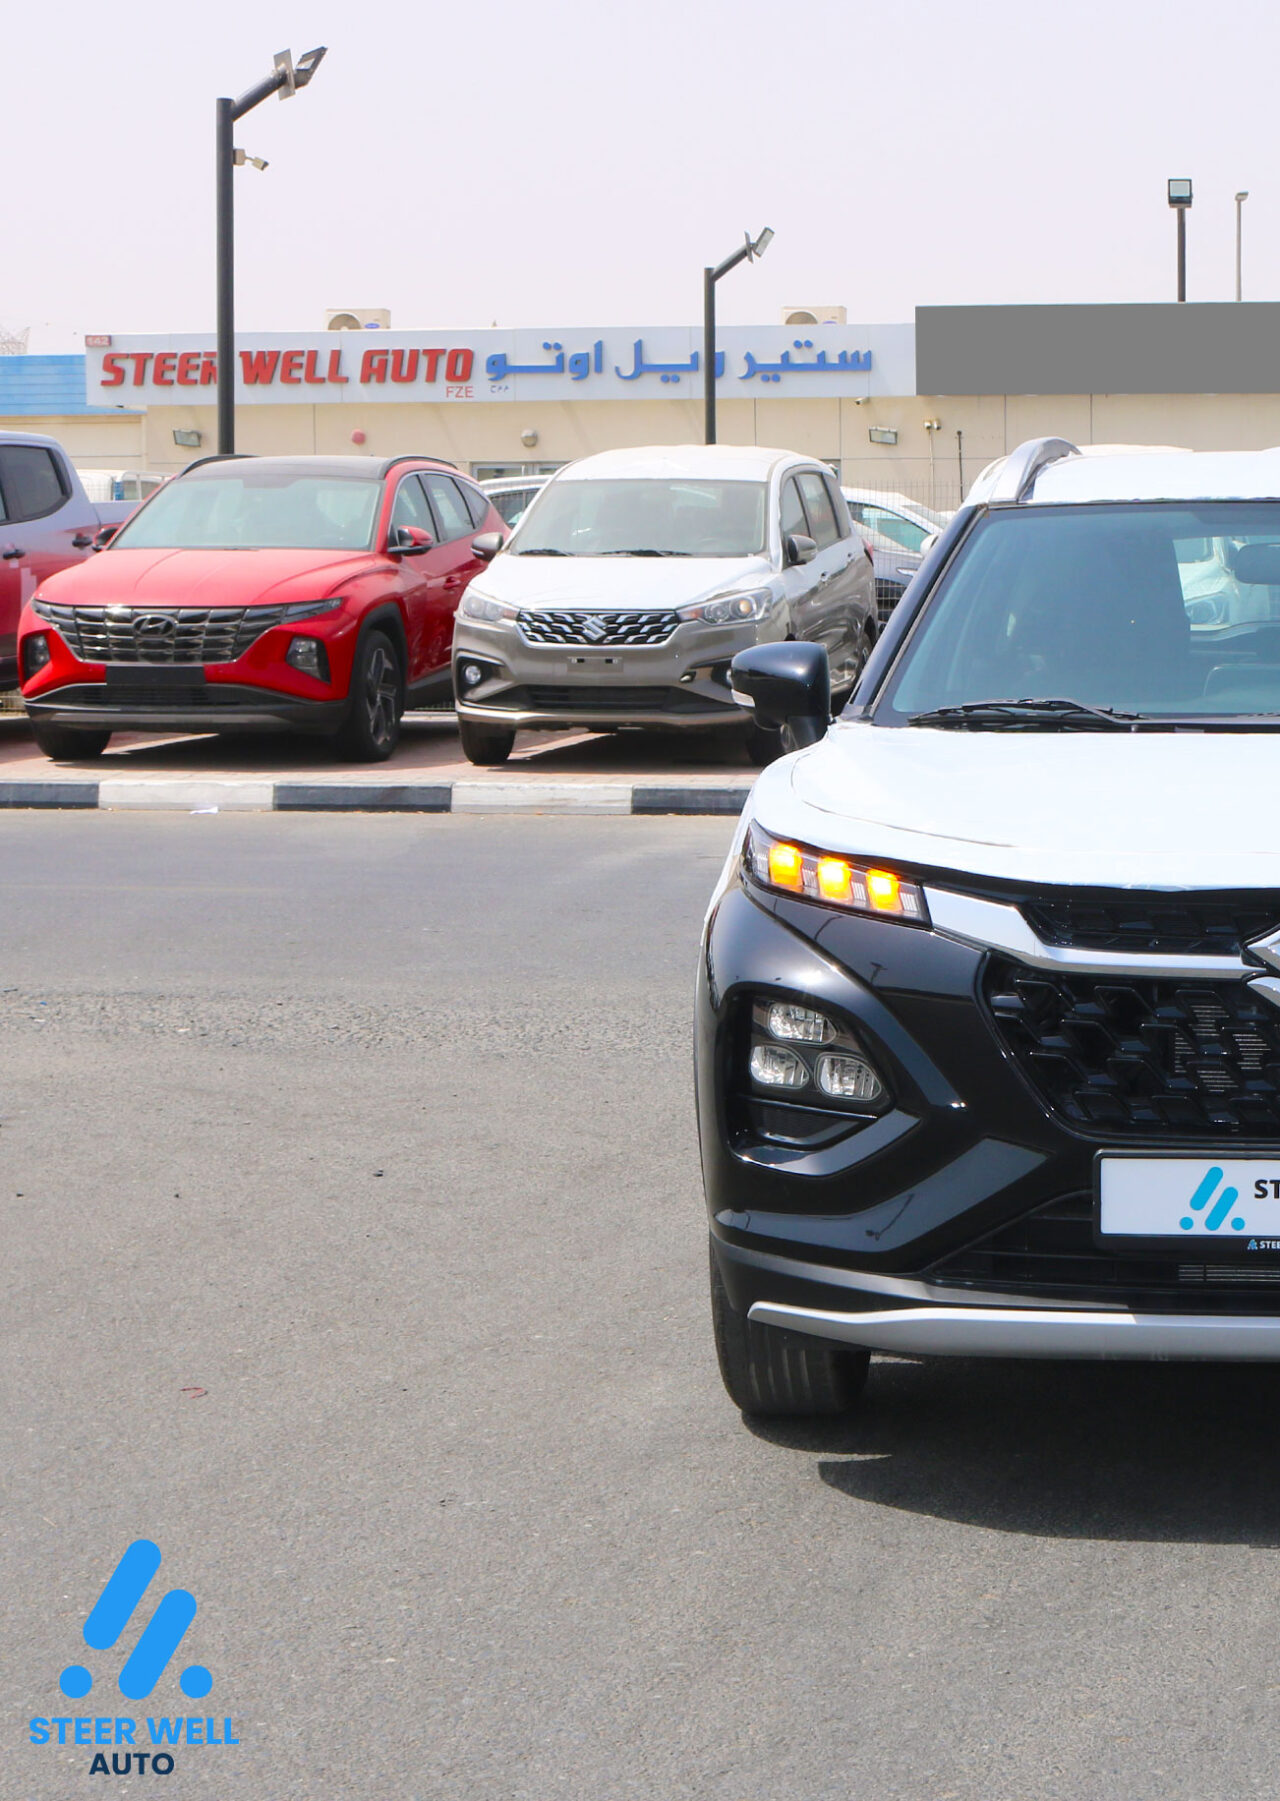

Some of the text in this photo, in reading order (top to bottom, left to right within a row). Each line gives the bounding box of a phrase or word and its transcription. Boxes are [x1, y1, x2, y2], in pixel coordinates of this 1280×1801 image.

[101, 349, 474, 386] STEER WELL AUTO
[486, 341, 603, 381] اوتو
[738, 339, 872, 382] ستير
[446, 386, 474, 398] FZE
